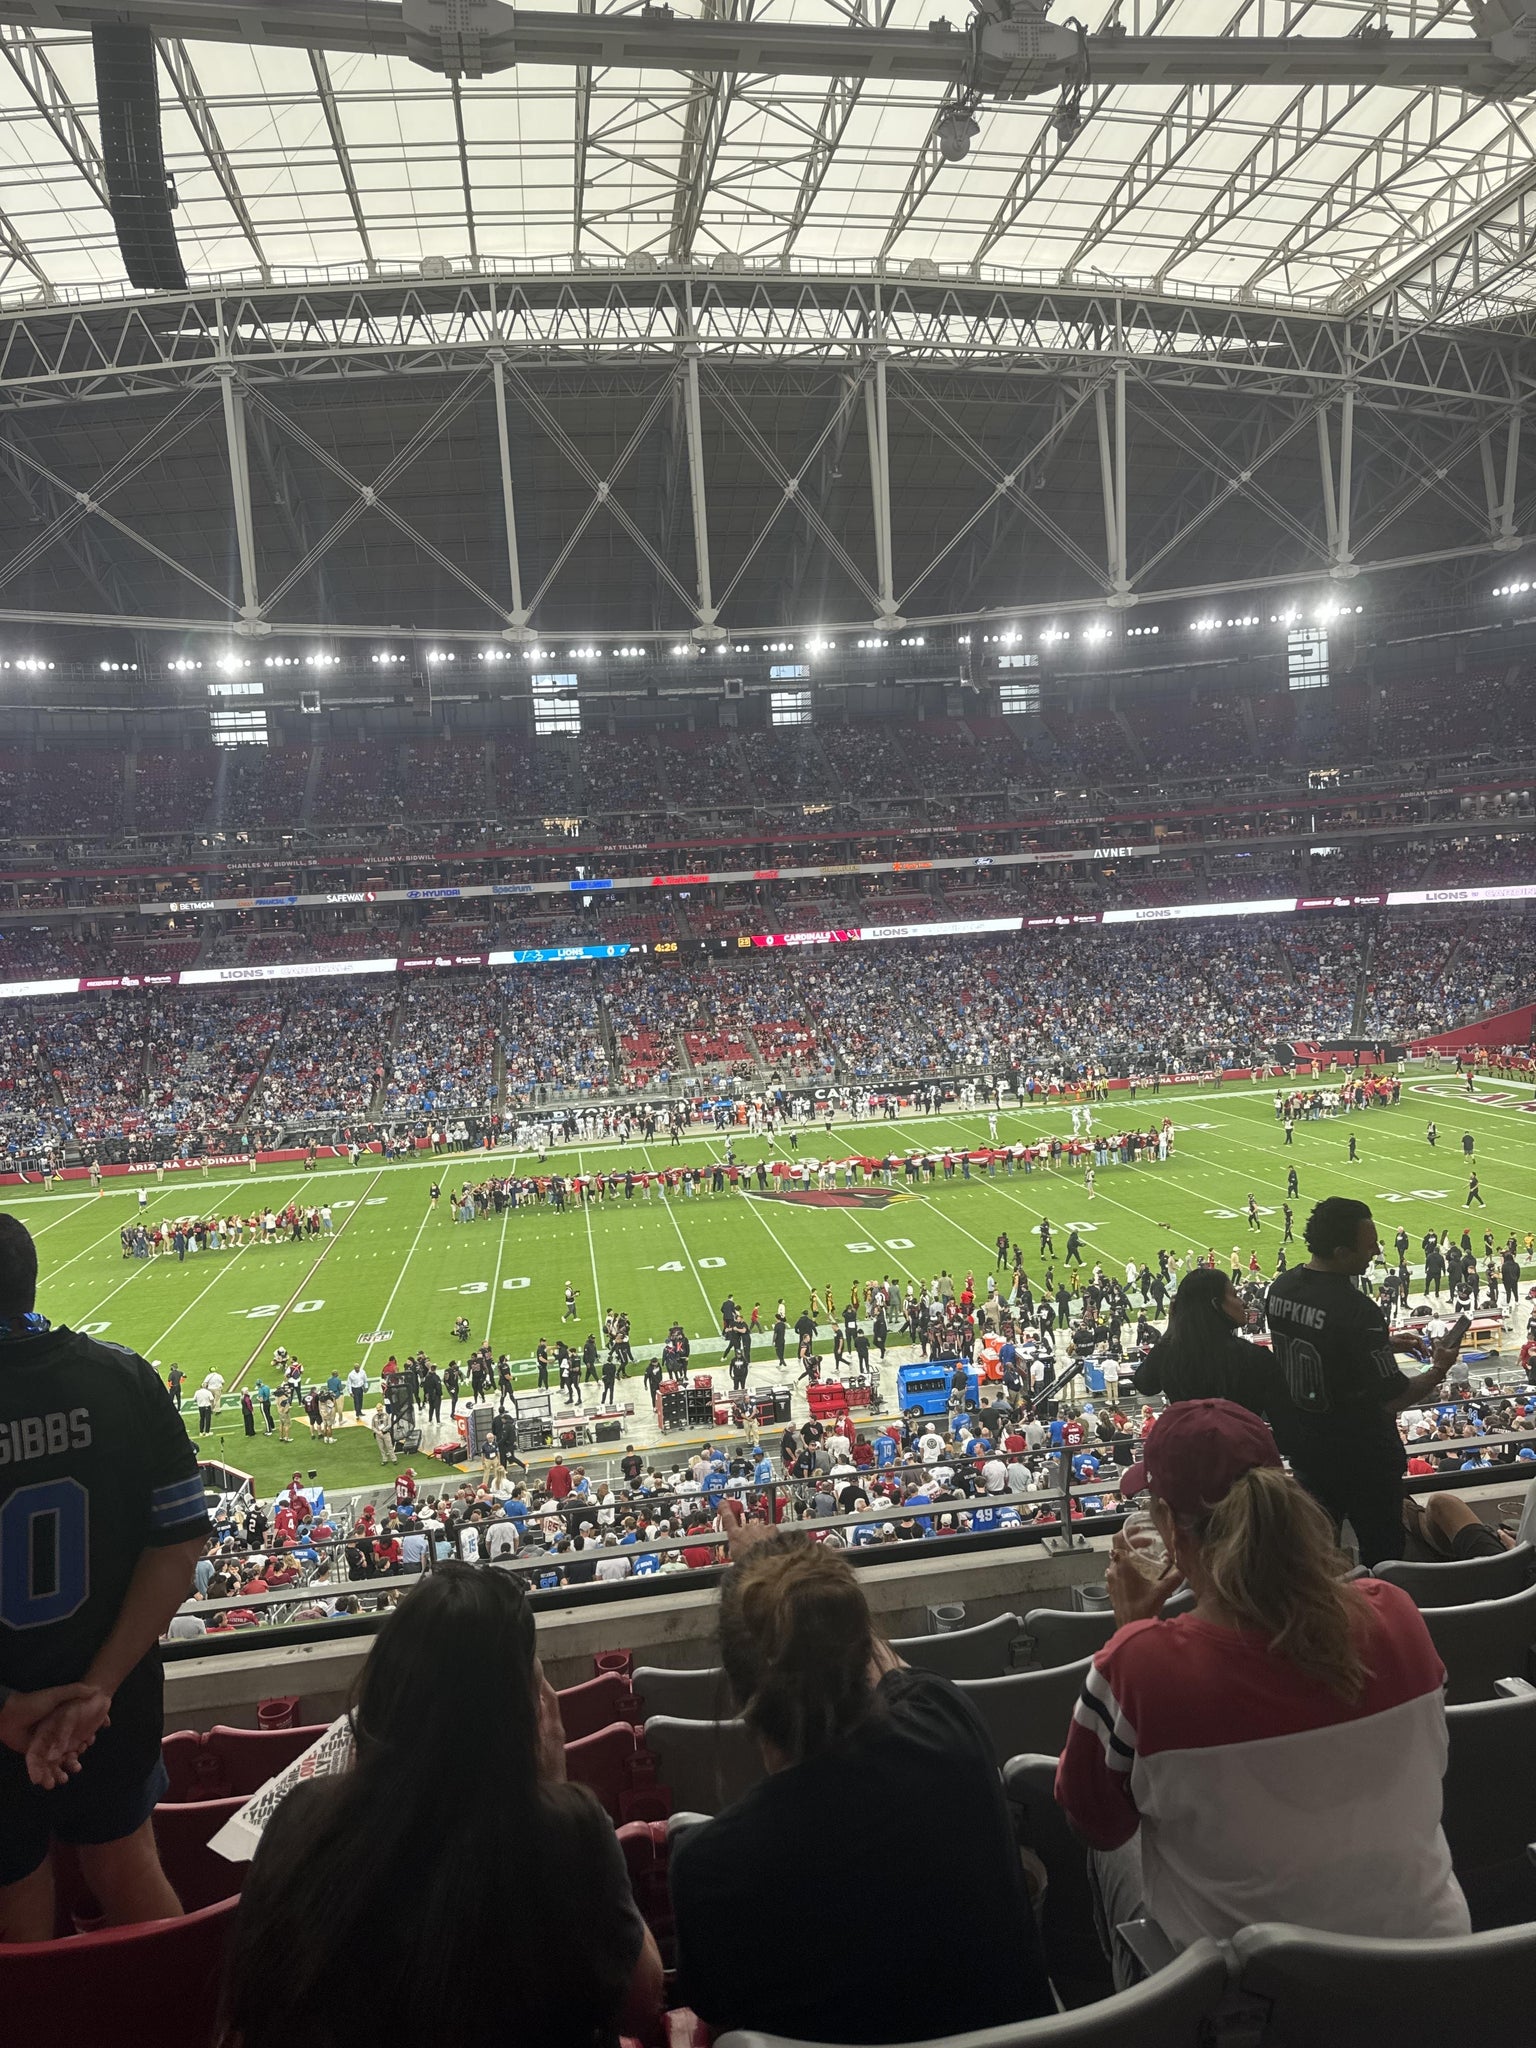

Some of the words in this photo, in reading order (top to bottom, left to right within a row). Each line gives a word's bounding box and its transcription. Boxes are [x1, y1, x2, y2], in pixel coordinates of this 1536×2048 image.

[1094, 847, 1133, 858] AVNET
[227, 862, 261, 870] CHARLES
[422, 888, 461, 897] HYUNDAI
[1426, 891, 1467, 901] LIONS
[326, 893, 365, 903] SAFEWAY
[179, 901, 215, 910] BETMGM
[1136, 909, 1171, 919] LIONS
[784, 931, 831, 942] CARDINALS
[872, 928, 909, 937] LIONS
[557, 948, 584, 957] LIONS
[654, 943, 678, 953] 4:26
[220, 969, 263, 979] LIONS
[185, 1155, 249, 1167] CADINALS
[844, 1238, 915, 1253] 50
[657, 1256, 727, 1272] 40
[459, 1277, 531, 1295] 30
[246, 1300, 325, 1318] 20
[1269, 1295, 1326, 1330] HOPKINS
[976, 1508, 993, 1522] 49
[288, 1518, 295, 1530] 4
